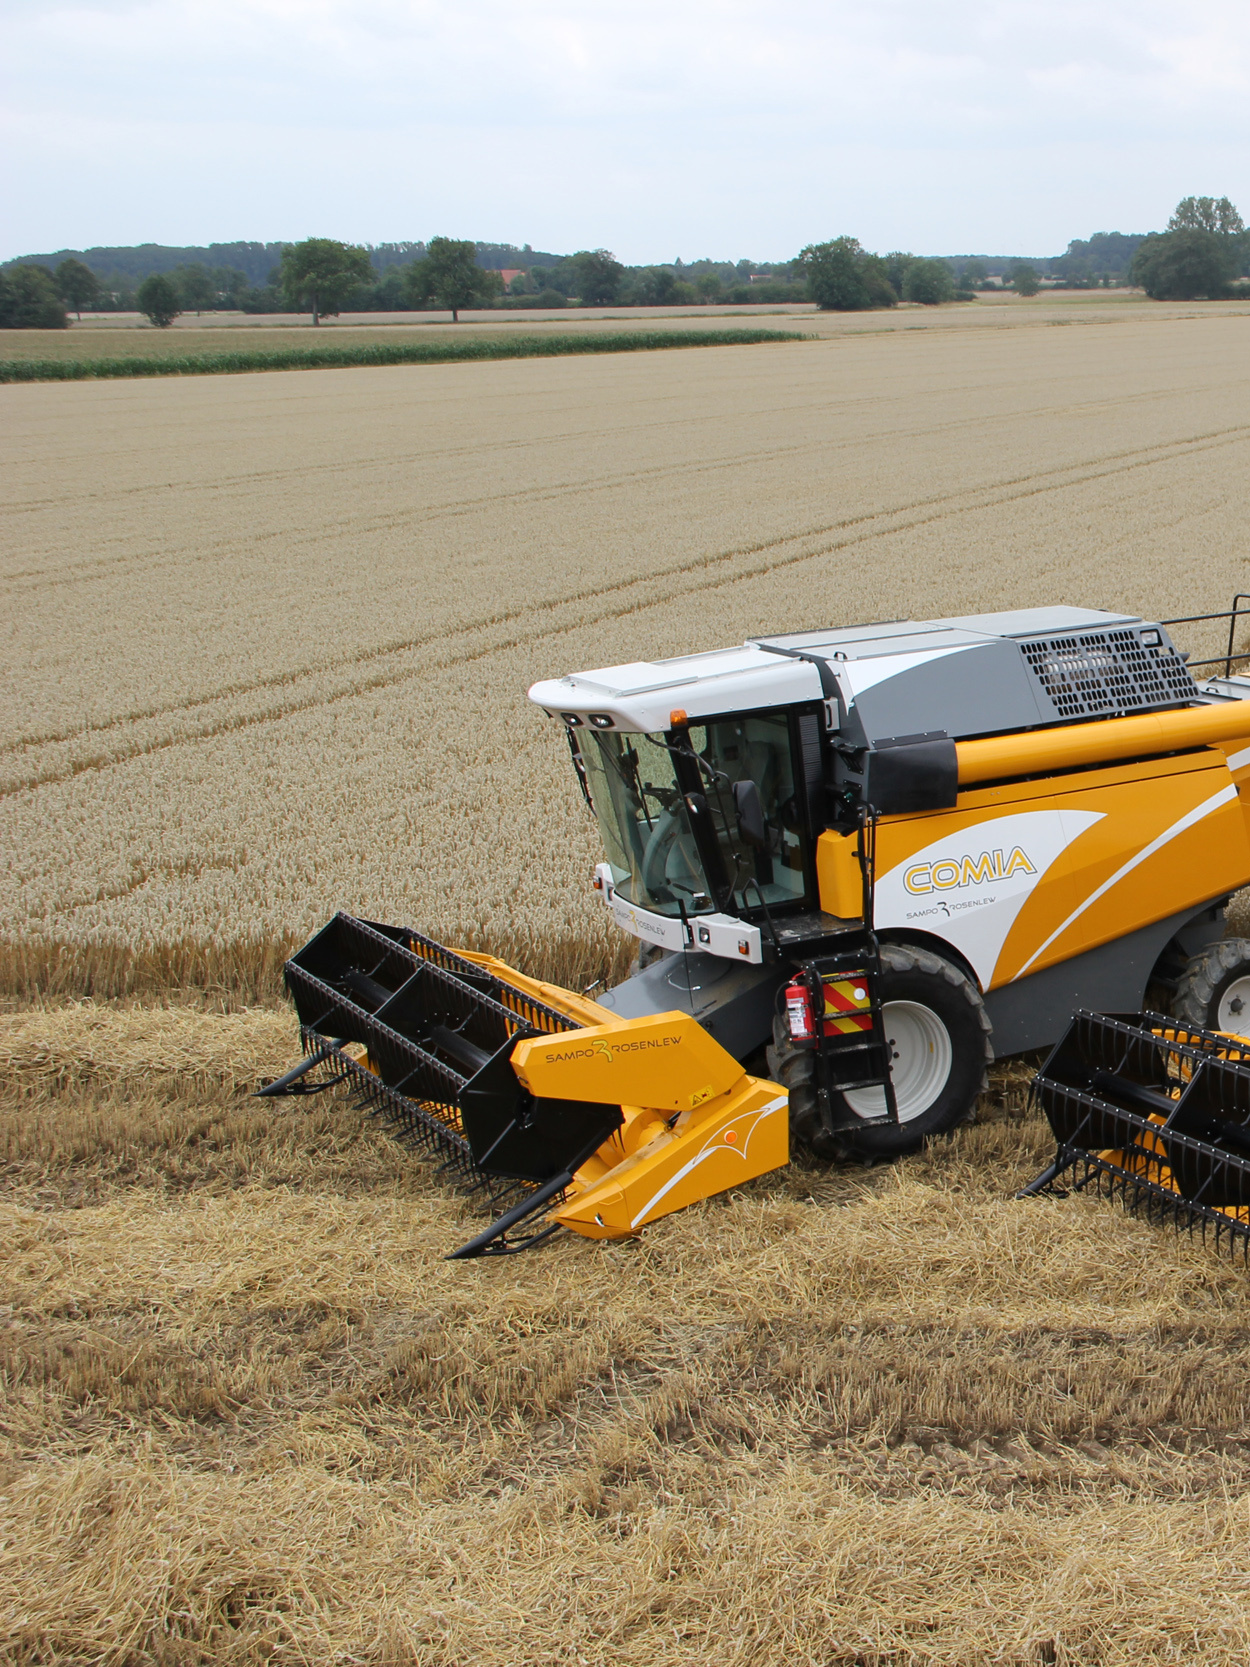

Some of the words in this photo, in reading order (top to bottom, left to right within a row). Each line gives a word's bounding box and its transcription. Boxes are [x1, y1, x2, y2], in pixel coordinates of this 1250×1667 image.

[903, 846, 1038, 896] COMIA
[906, 907, 938, 919] SAMPO
[949, 896, 996, 911] ROSENLEW
[545, 1049, 595, 1063] SAMPO
[611, 1036, 682, 1053] ROSENLEW
